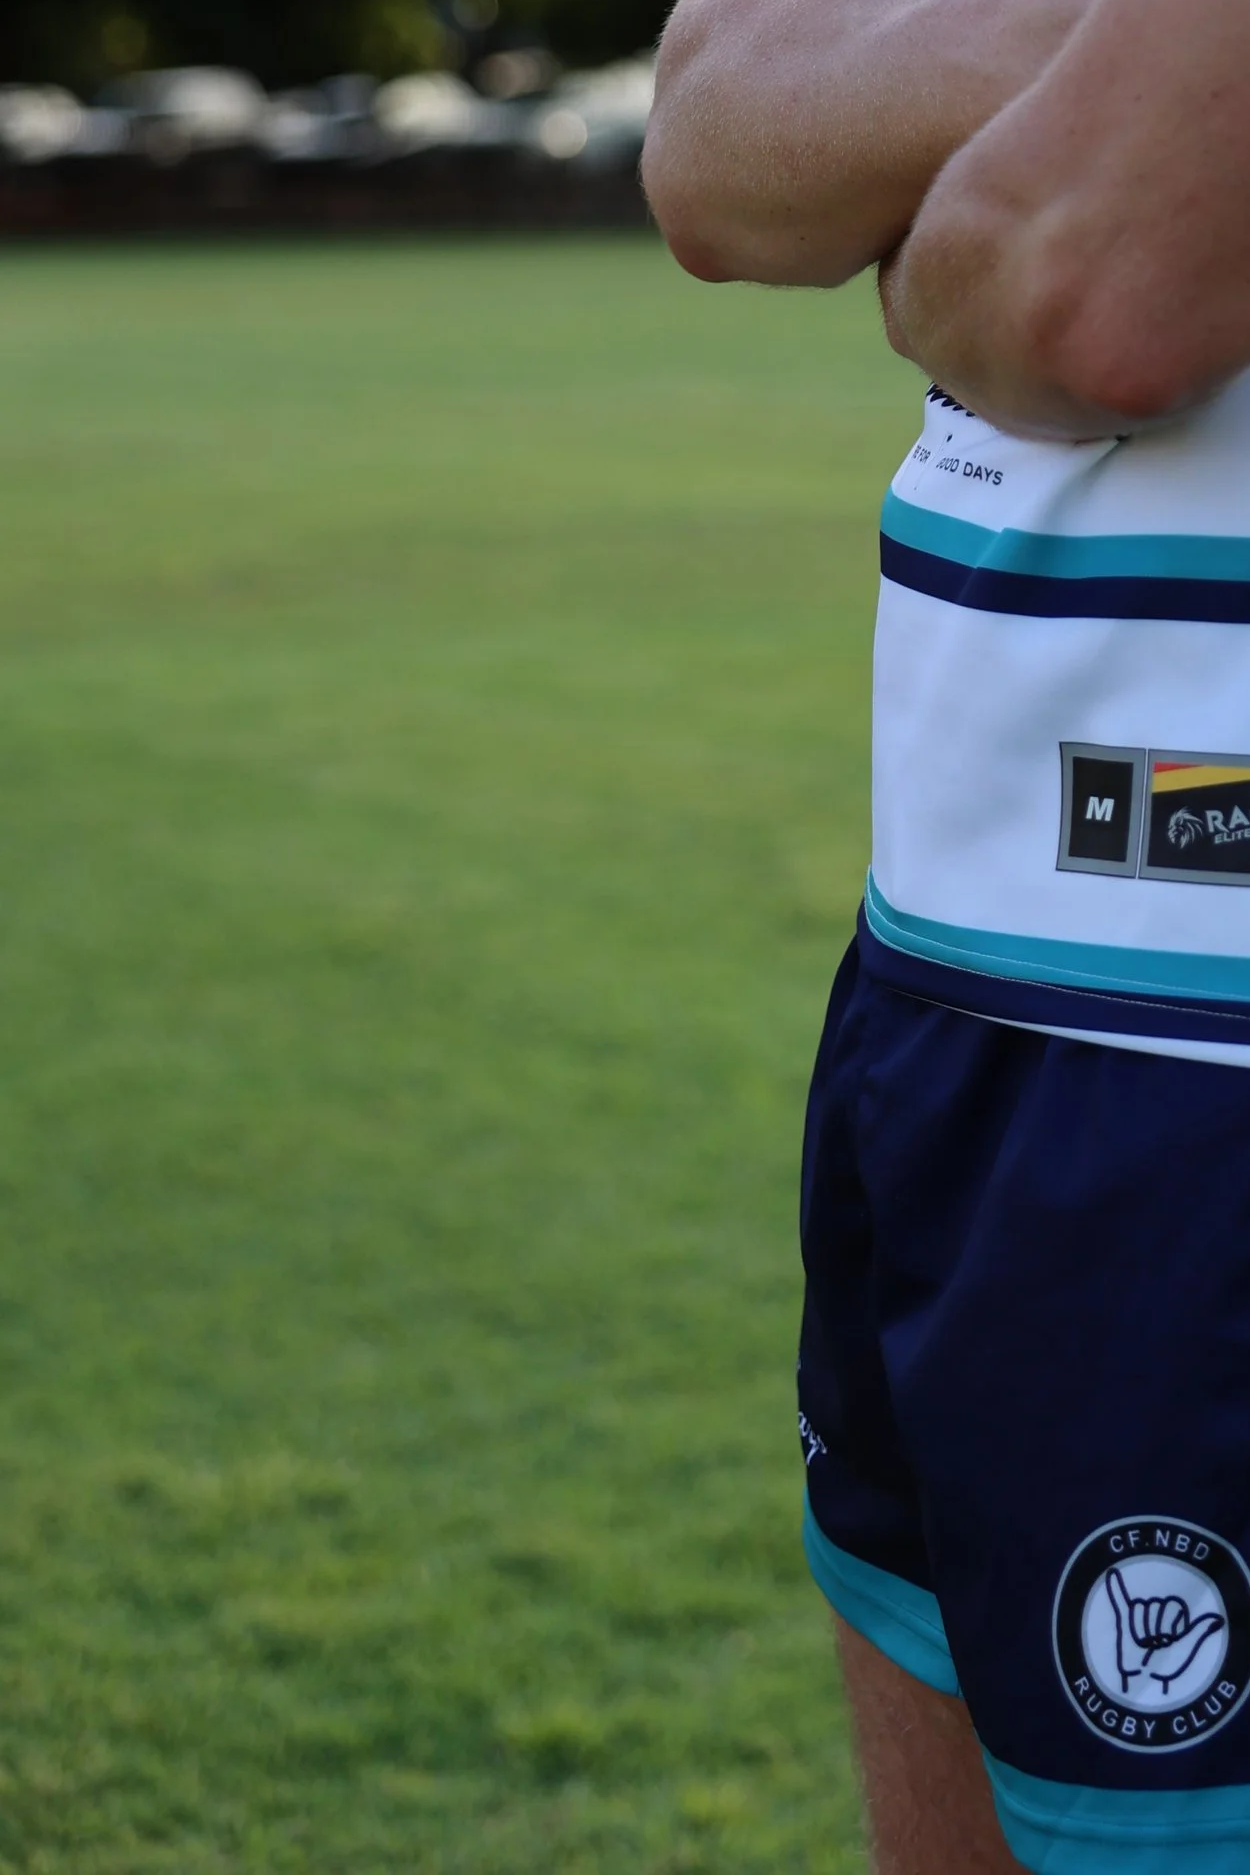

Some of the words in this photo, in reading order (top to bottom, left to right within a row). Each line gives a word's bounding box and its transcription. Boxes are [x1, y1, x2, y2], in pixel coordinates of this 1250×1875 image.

[963, 461, 1003, 486] DAYS
[1085, 796, 1115, 822] M
[1074, 1676, 1156, 1738] RUGBY
[1172, 1680, 1238, 1735] CLUB
